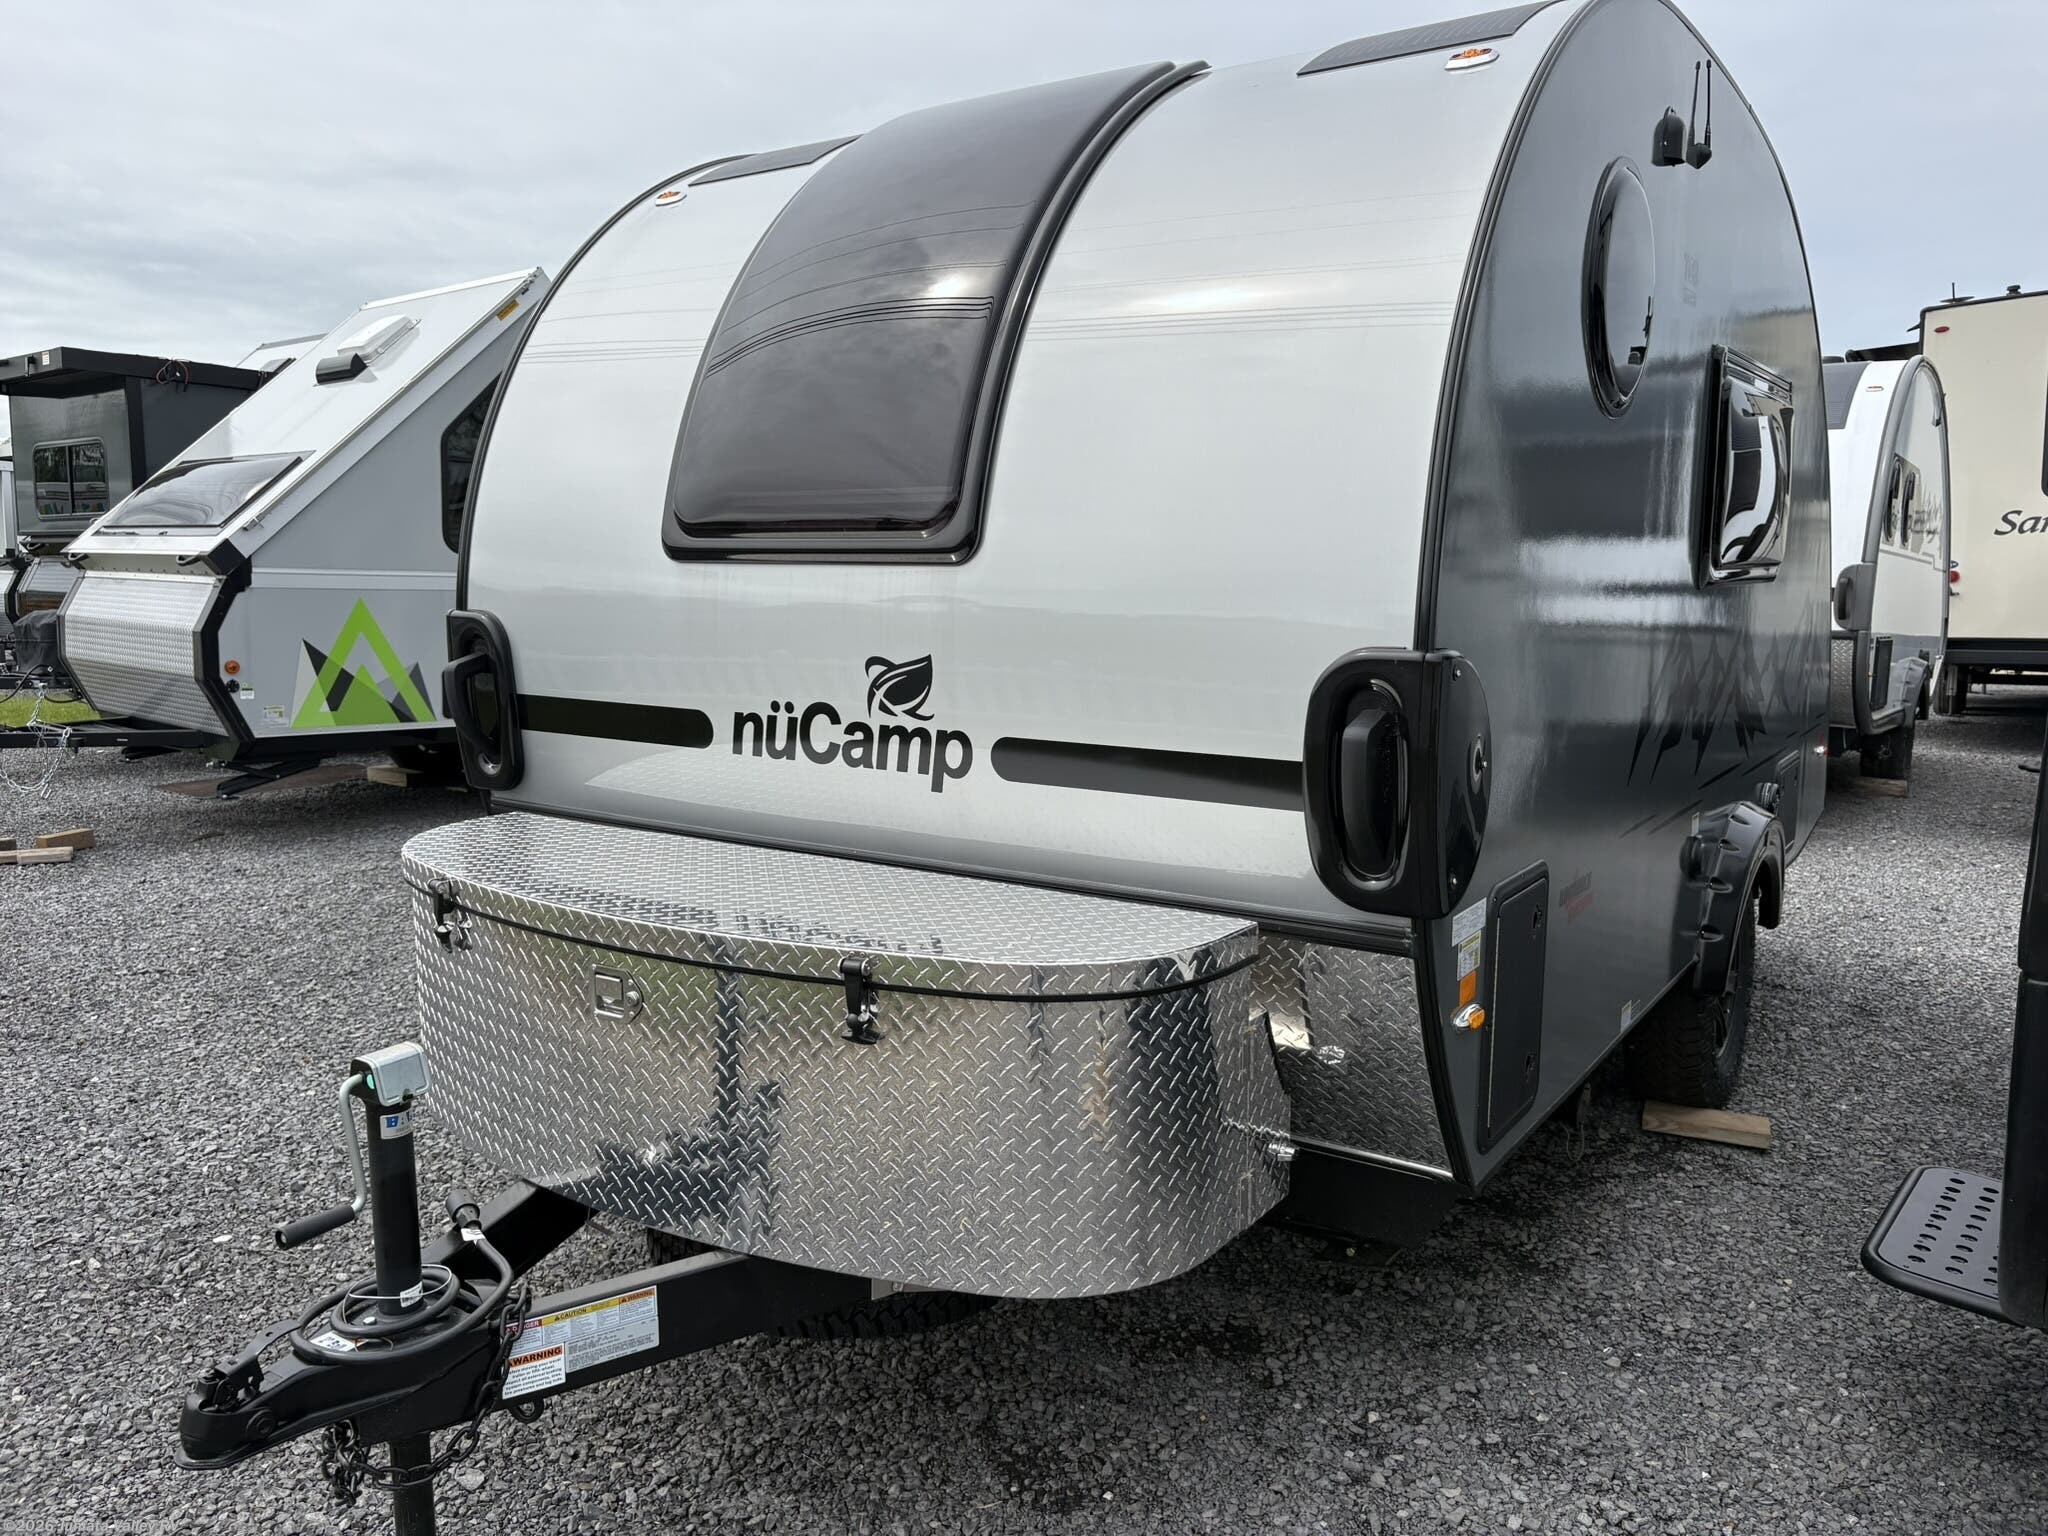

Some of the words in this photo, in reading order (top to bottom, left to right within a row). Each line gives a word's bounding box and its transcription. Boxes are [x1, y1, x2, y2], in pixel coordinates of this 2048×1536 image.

[731, 700, 974, 793] nüCamp
[560, 1308, 587, 1320] CAUTION
[513, 1347, 562, 1365] WARNING
